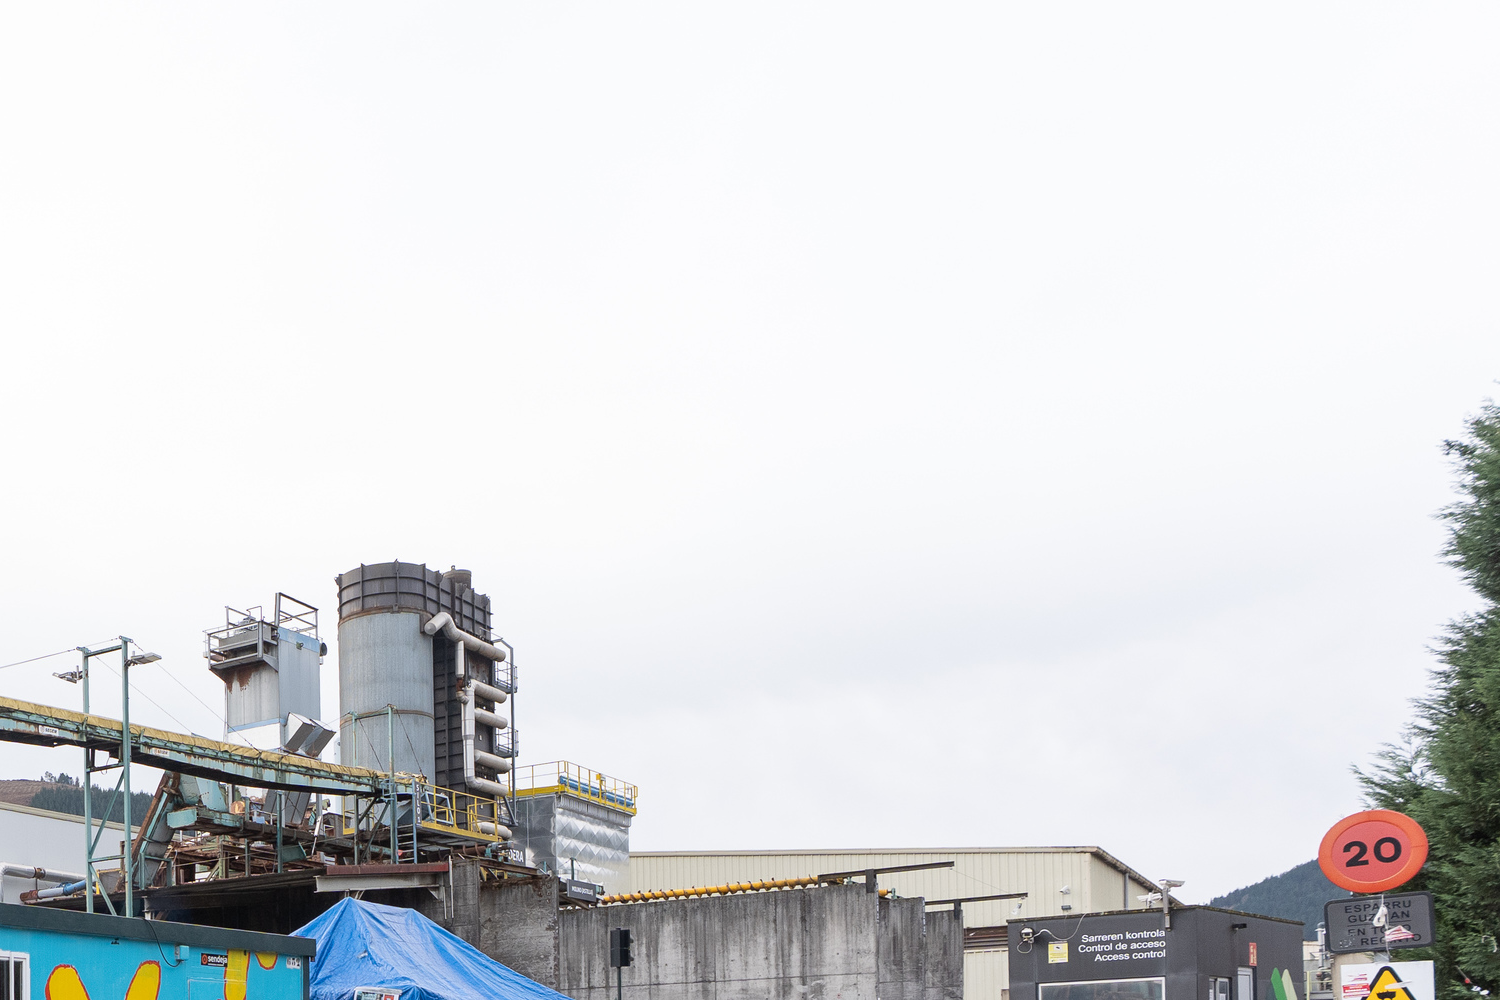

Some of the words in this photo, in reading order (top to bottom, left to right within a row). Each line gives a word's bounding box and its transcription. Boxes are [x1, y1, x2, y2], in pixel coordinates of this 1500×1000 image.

[1343, 836, 1402, 868] 20
[1348, 910, 1410, 923] GUZAN
[1081, 933, 1123, 943] Sarreren
[1126, 929, 1166, 940] kontrola
[1078, 943, 1113, 953] Control
[1115, 942, 1128, 950] de
[1130, 940, 1166, 949] acceso
[208, 955, 228, 965] sendeja
[1094, 953, 1130, 962] Access
[1132, 949, 1166, 960] control
